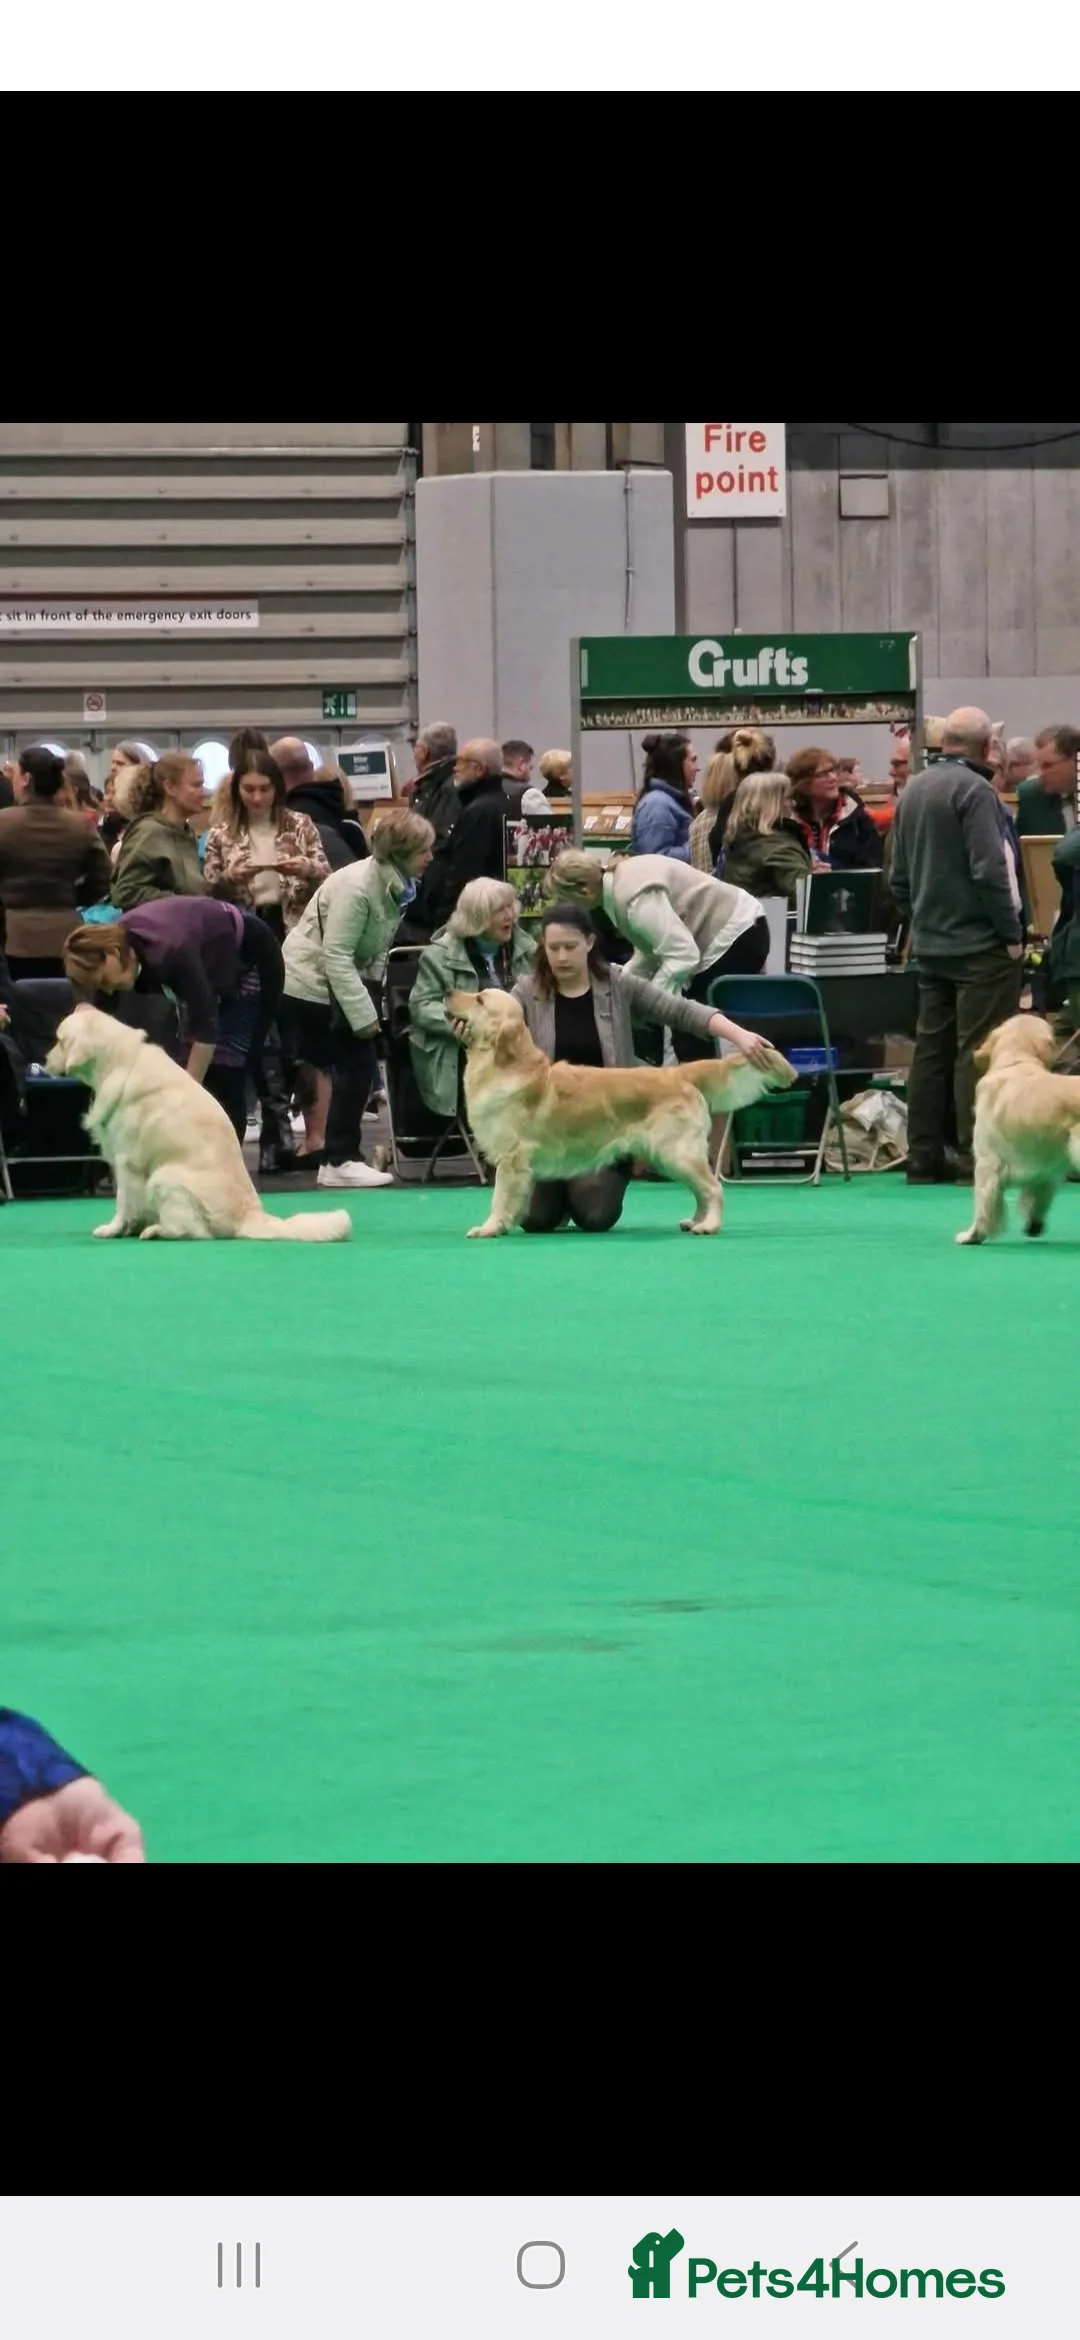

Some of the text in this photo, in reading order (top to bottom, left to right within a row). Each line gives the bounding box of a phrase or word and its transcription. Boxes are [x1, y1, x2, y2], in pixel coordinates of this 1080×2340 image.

[704, 423, 766, 453] Fire
[695, 464, 778, 500] point
[6, 609, 21, 621] sit
[25, 609, 36, 621] in
[40, 608, 71, 621] front
[75, 608, 88, 621] of
[92, 609, 112, 621] the
[117, 610, 185, 624] emergency
[189, 608, 212, 621] exit
[216, 608, 252, 620] doors
[688, 639, 809, 687] Crufts
